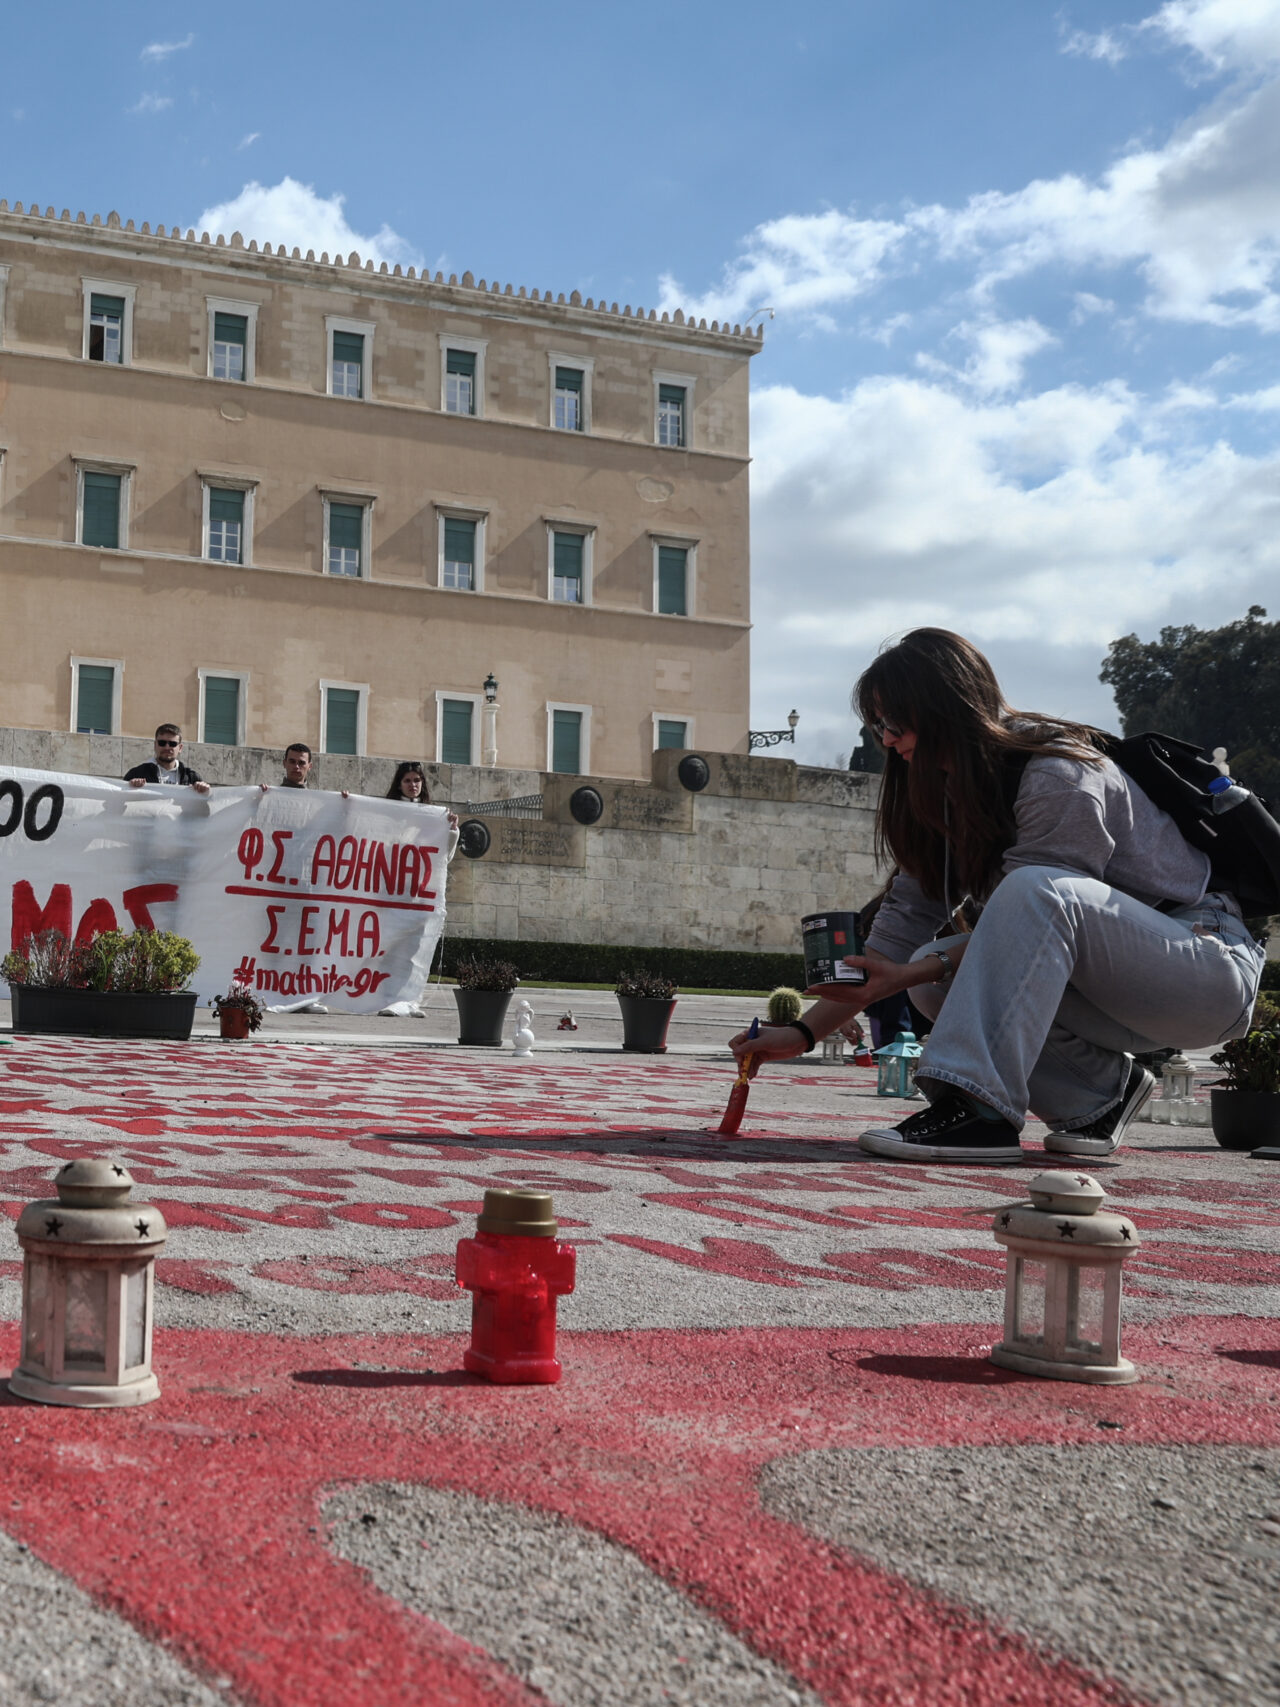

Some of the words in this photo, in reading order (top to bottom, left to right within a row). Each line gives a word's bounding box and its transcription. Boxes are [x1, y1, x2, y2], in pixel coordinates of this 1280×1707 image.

[237, 827, 299, 886] Φ.Σ.
[310, 834, 440, 899] ΑΘΗΝΑΣ
[260, 904, 385, 958] Σ.Ε.Μ.Α.
